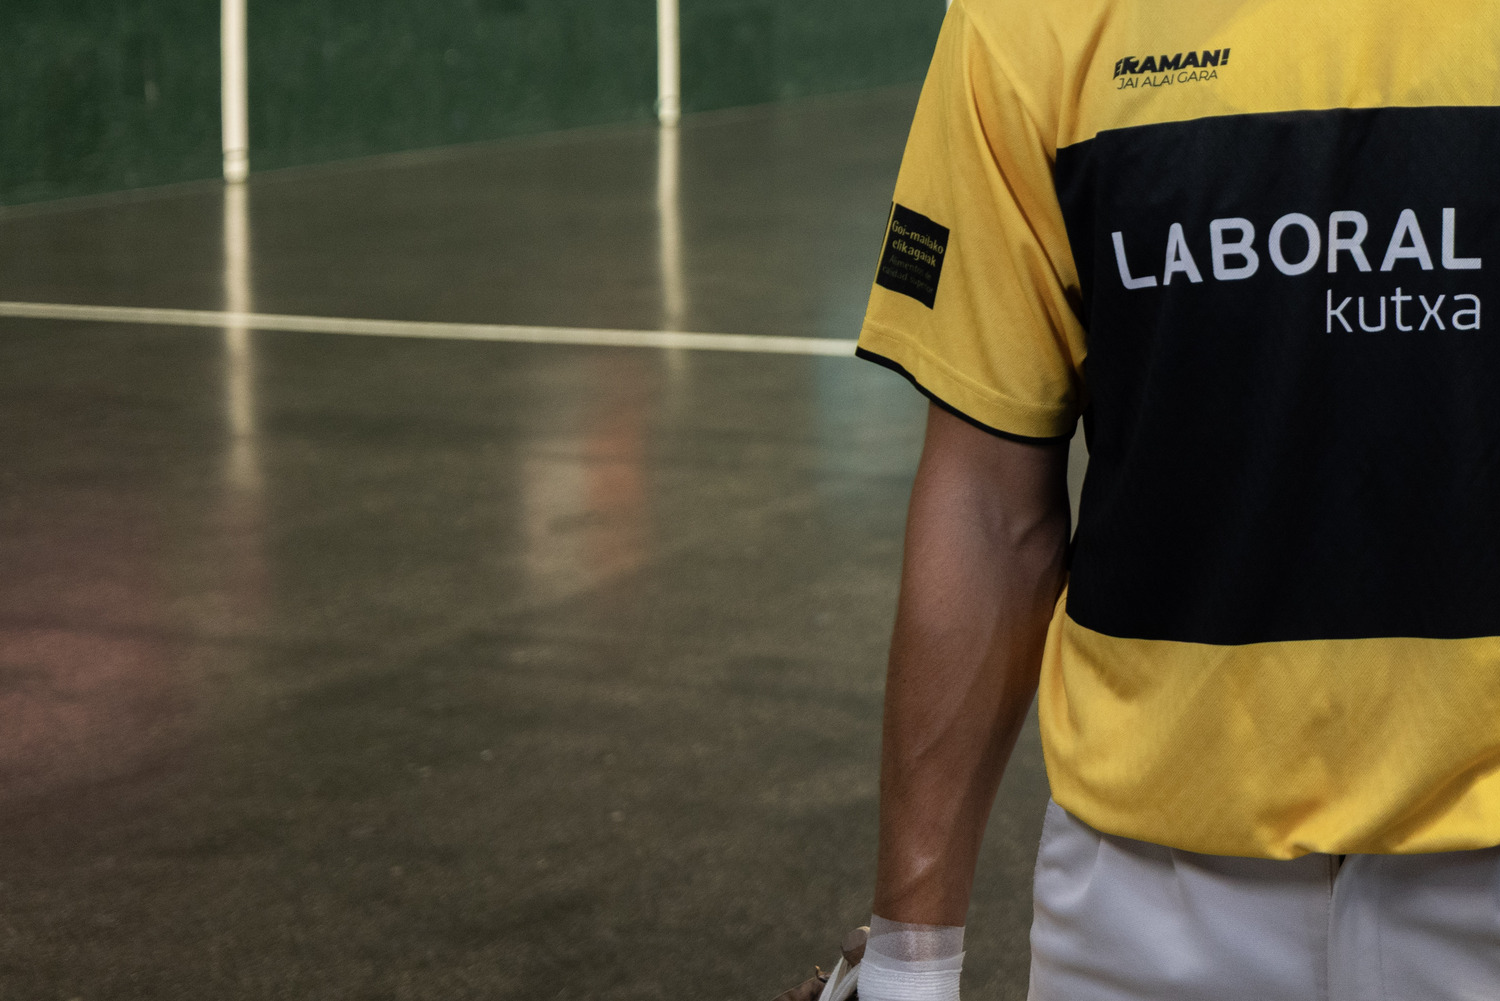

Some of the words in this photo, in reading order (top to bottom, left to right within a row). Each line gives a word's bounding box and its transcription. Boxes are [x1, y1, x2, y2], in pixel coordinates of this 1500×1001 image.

[1117, 77, 1139, 90] JAI
[1141, 74, 1174, 88] ALAI
[1177, 69, 1218, 83] GARA
[1111, 207, 1482, 290] LABORAL
[1327, 287, 1481, 334] kutxa
